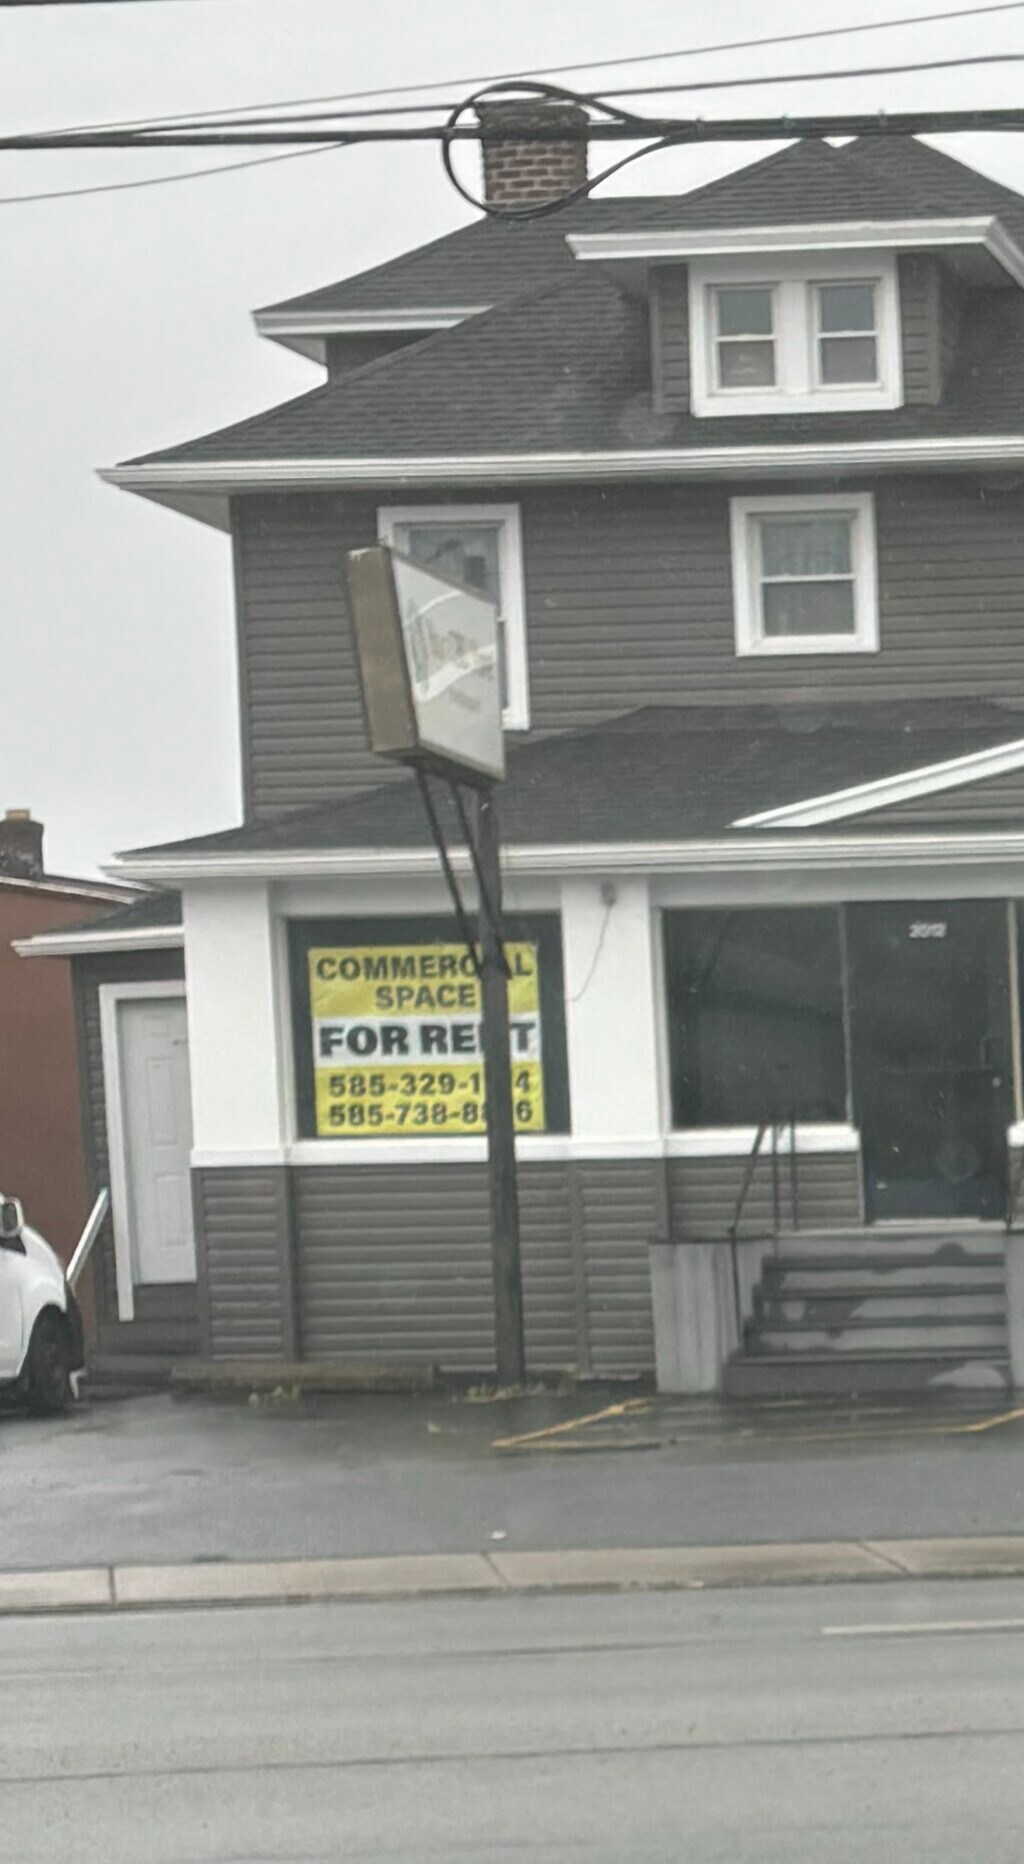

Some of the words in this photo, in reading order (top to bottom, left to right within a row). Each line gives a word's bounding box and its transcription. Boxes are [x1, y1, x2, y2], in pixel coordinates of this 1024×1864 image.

[316, 953, 533, 981] COMMERCL
[375, 984, 477, 1009] SPACE
[319, 1025, 409, 1058] FOR
[420, 1022, 536, 1055] RET
[328, 1070, 531, 1098] 585-329-14
[328, 1100, 533, 1127] 585-738-86
